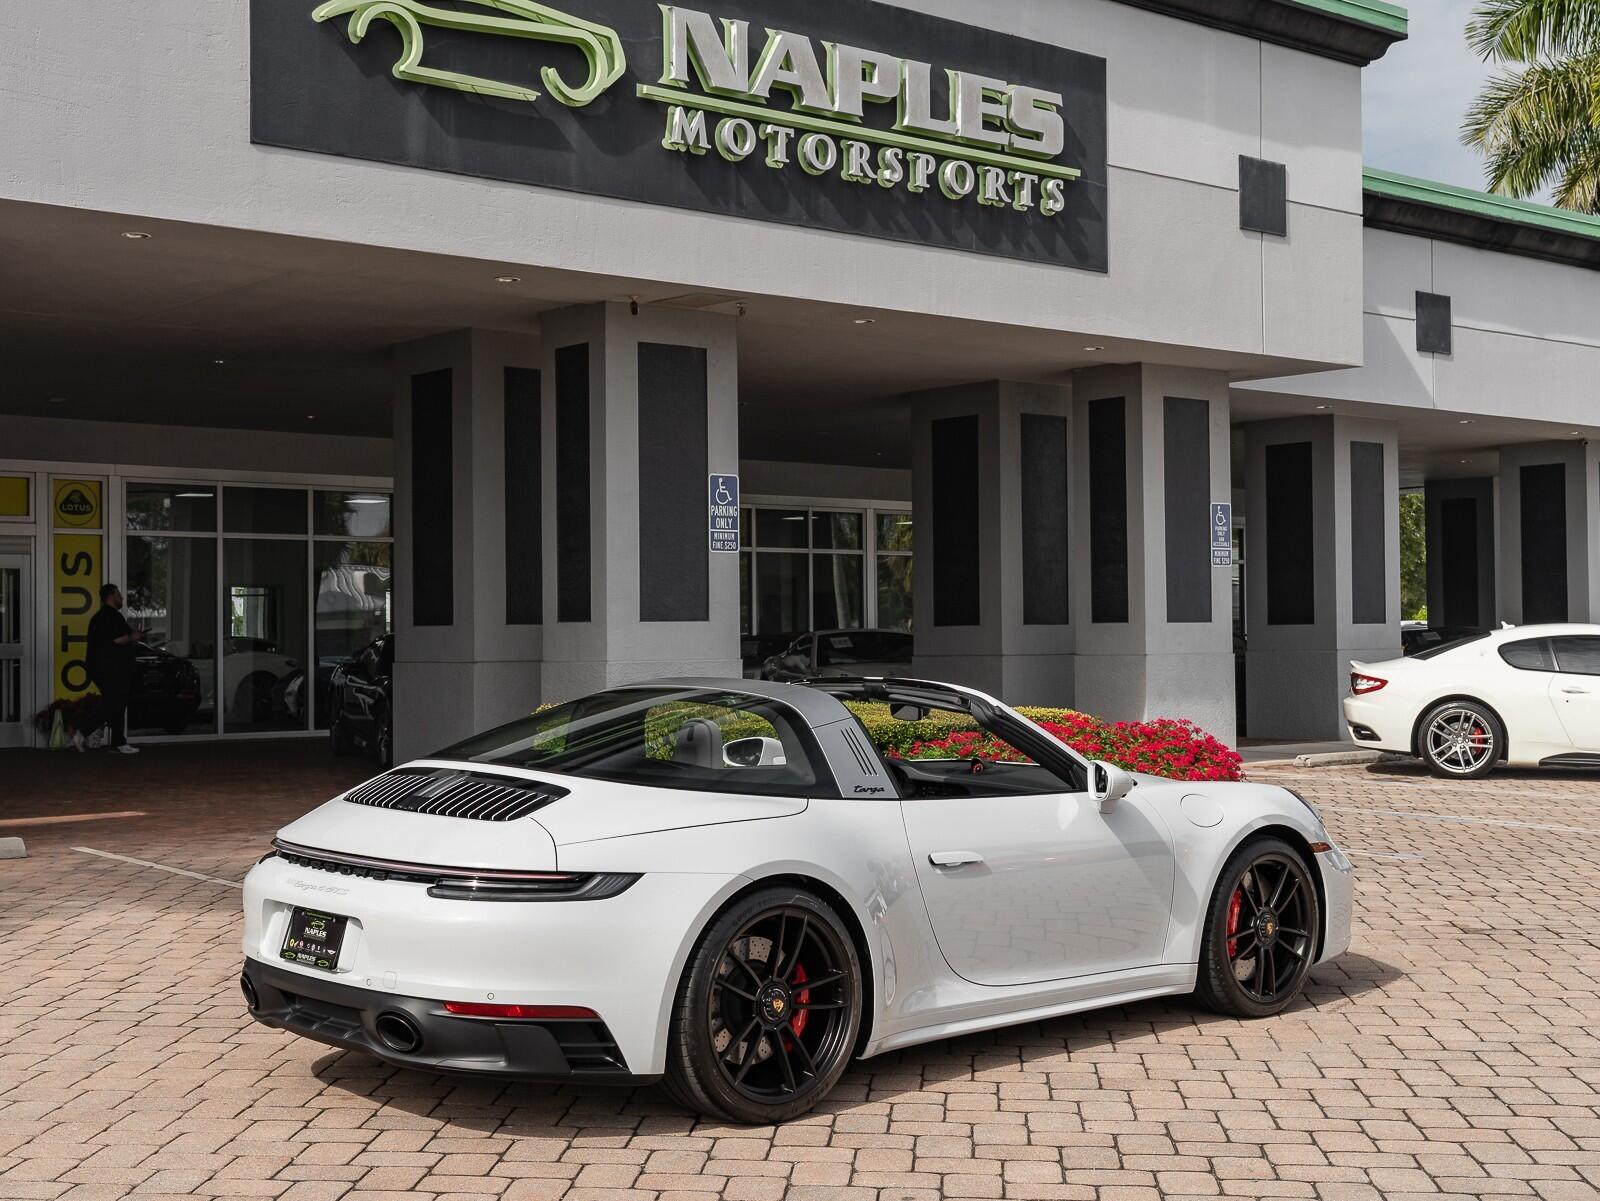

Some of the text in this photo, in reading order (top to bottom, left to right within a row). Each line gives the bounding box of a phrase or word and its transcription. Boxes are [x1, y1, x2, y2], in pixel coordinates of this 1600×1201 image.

[658, 3, 1065, 160] NAPLES
[661, 106, 1065, 216] MOTORSPORTS
[62, 503, 92, 512] LOTUS
[711, 505, 738, 517] PARKING
[715, 518, 733, 528] ONLY
[712, 541, 737, 550] FINE $250
[61, 551, 93, 692] OTUS
[853, 785, 885, 795] targa
[304, 927, 327, 938] NAPLES
